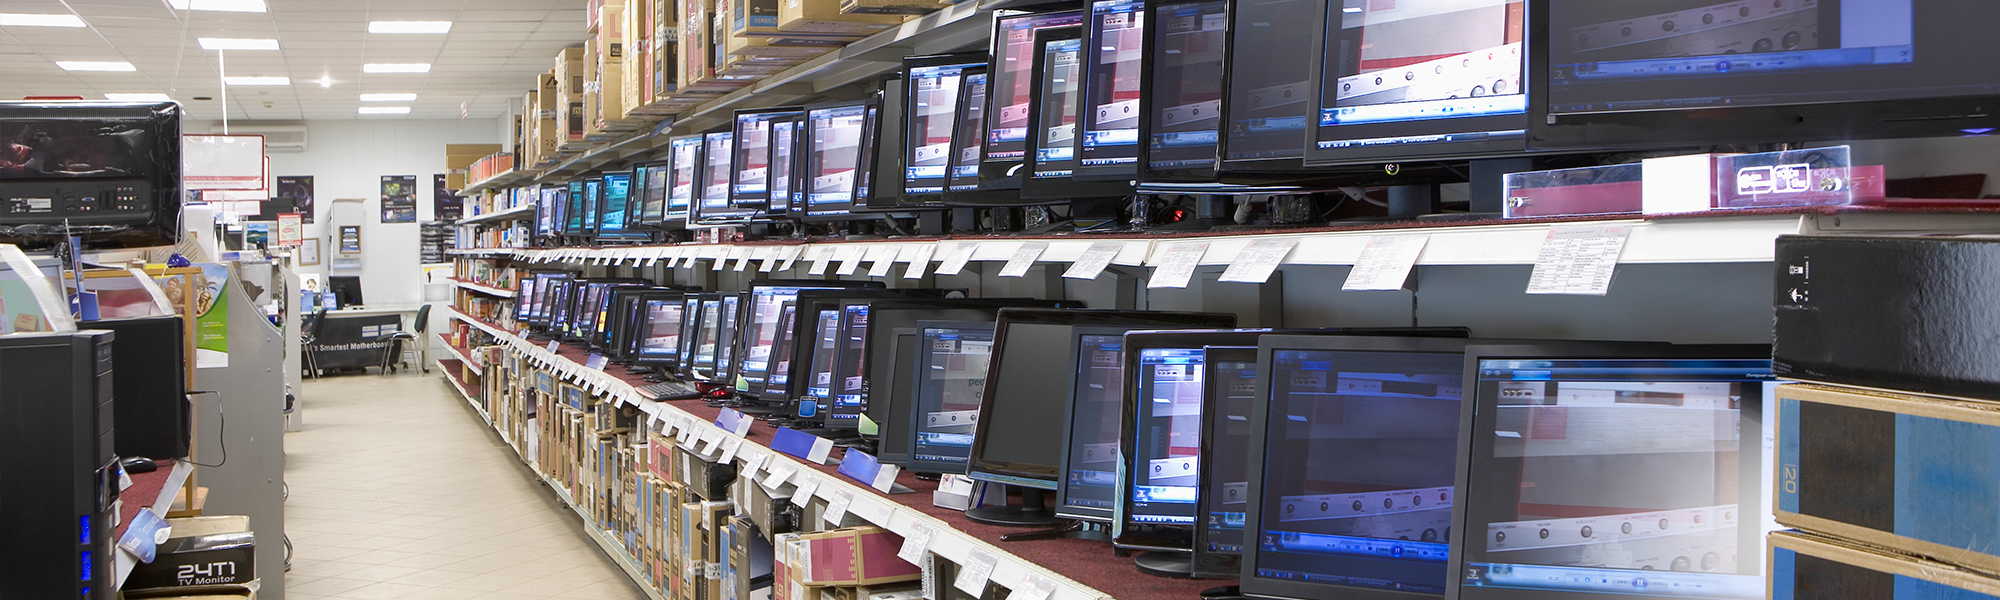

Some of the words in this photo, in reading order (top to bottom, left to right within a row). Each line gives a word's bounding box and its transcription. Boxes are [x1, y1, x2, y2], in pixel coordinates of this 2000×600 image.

[320, 343, 349, 352] Smartest
[1785, 466, 1796, 493] 20
[177, 561, 235, 579] 24T1
[195, 575, 236, 585] Monitor
